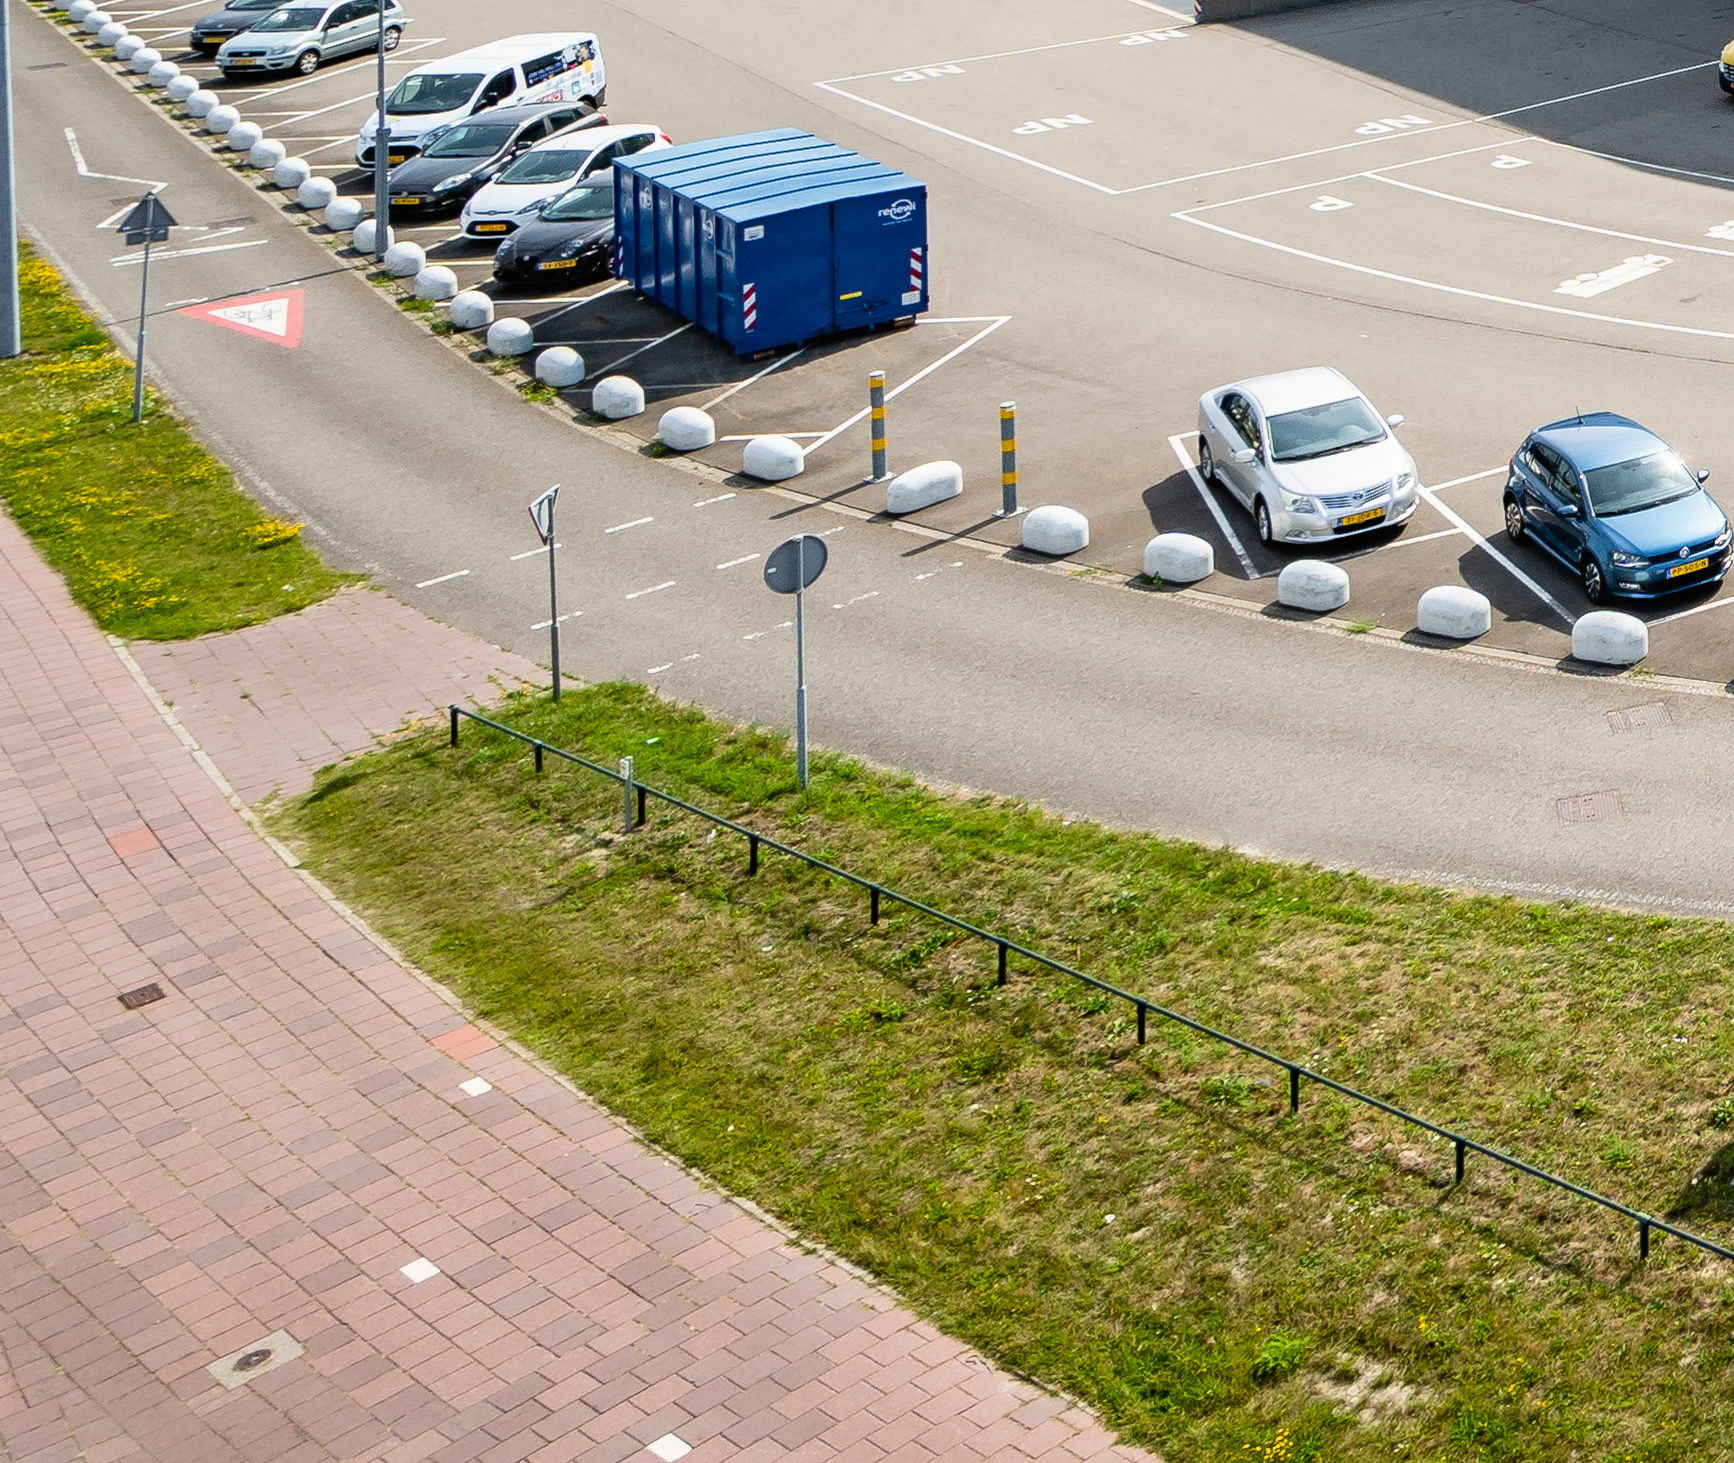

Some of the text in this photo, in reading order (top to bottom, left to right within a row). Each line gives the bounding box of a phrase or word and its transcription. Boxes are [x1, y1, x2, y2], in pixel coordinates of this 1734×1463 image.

[1011, 114, 1094, 136] NP
[1354, 114, 1433, 136] NP
[1490, 154, 1533, 170] P
[877, 200, 917, 217] renewi
[1309, 195, 1355, 212] P
